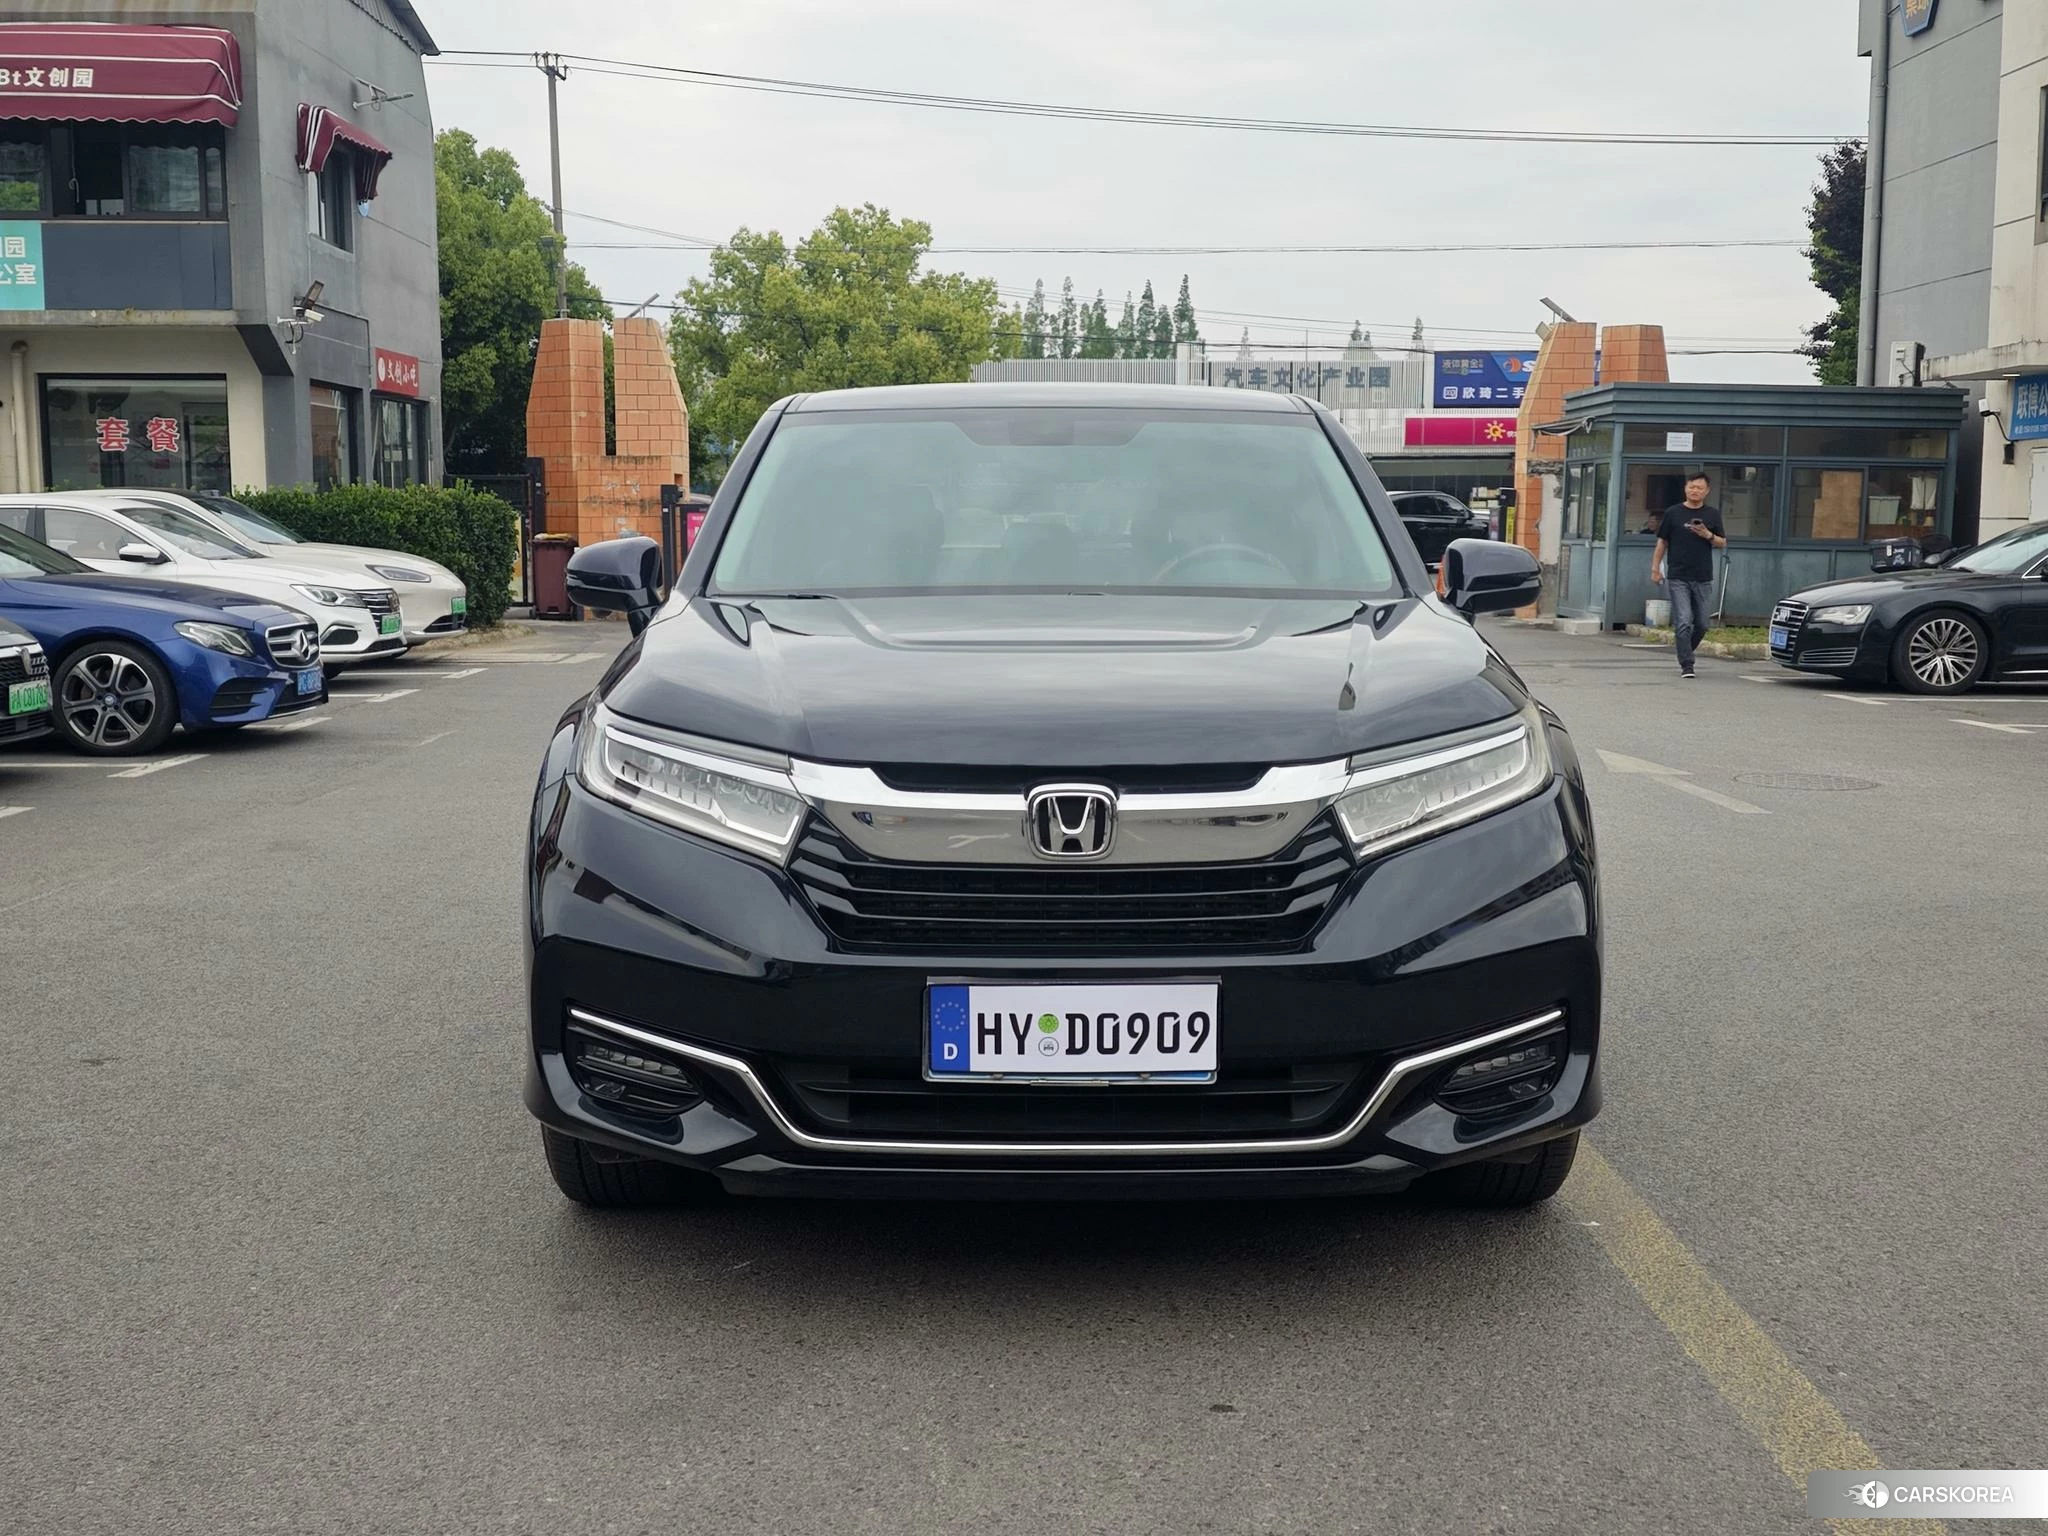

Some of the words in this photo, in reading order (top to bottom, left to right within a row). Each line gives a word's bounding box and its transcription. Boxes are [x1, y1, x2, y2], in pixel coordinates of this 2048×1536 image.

[96, 416, 180, 452] 套餐
[943, 1043, 958, 1060] D
[977, 1013, 1033, 1055] HY
